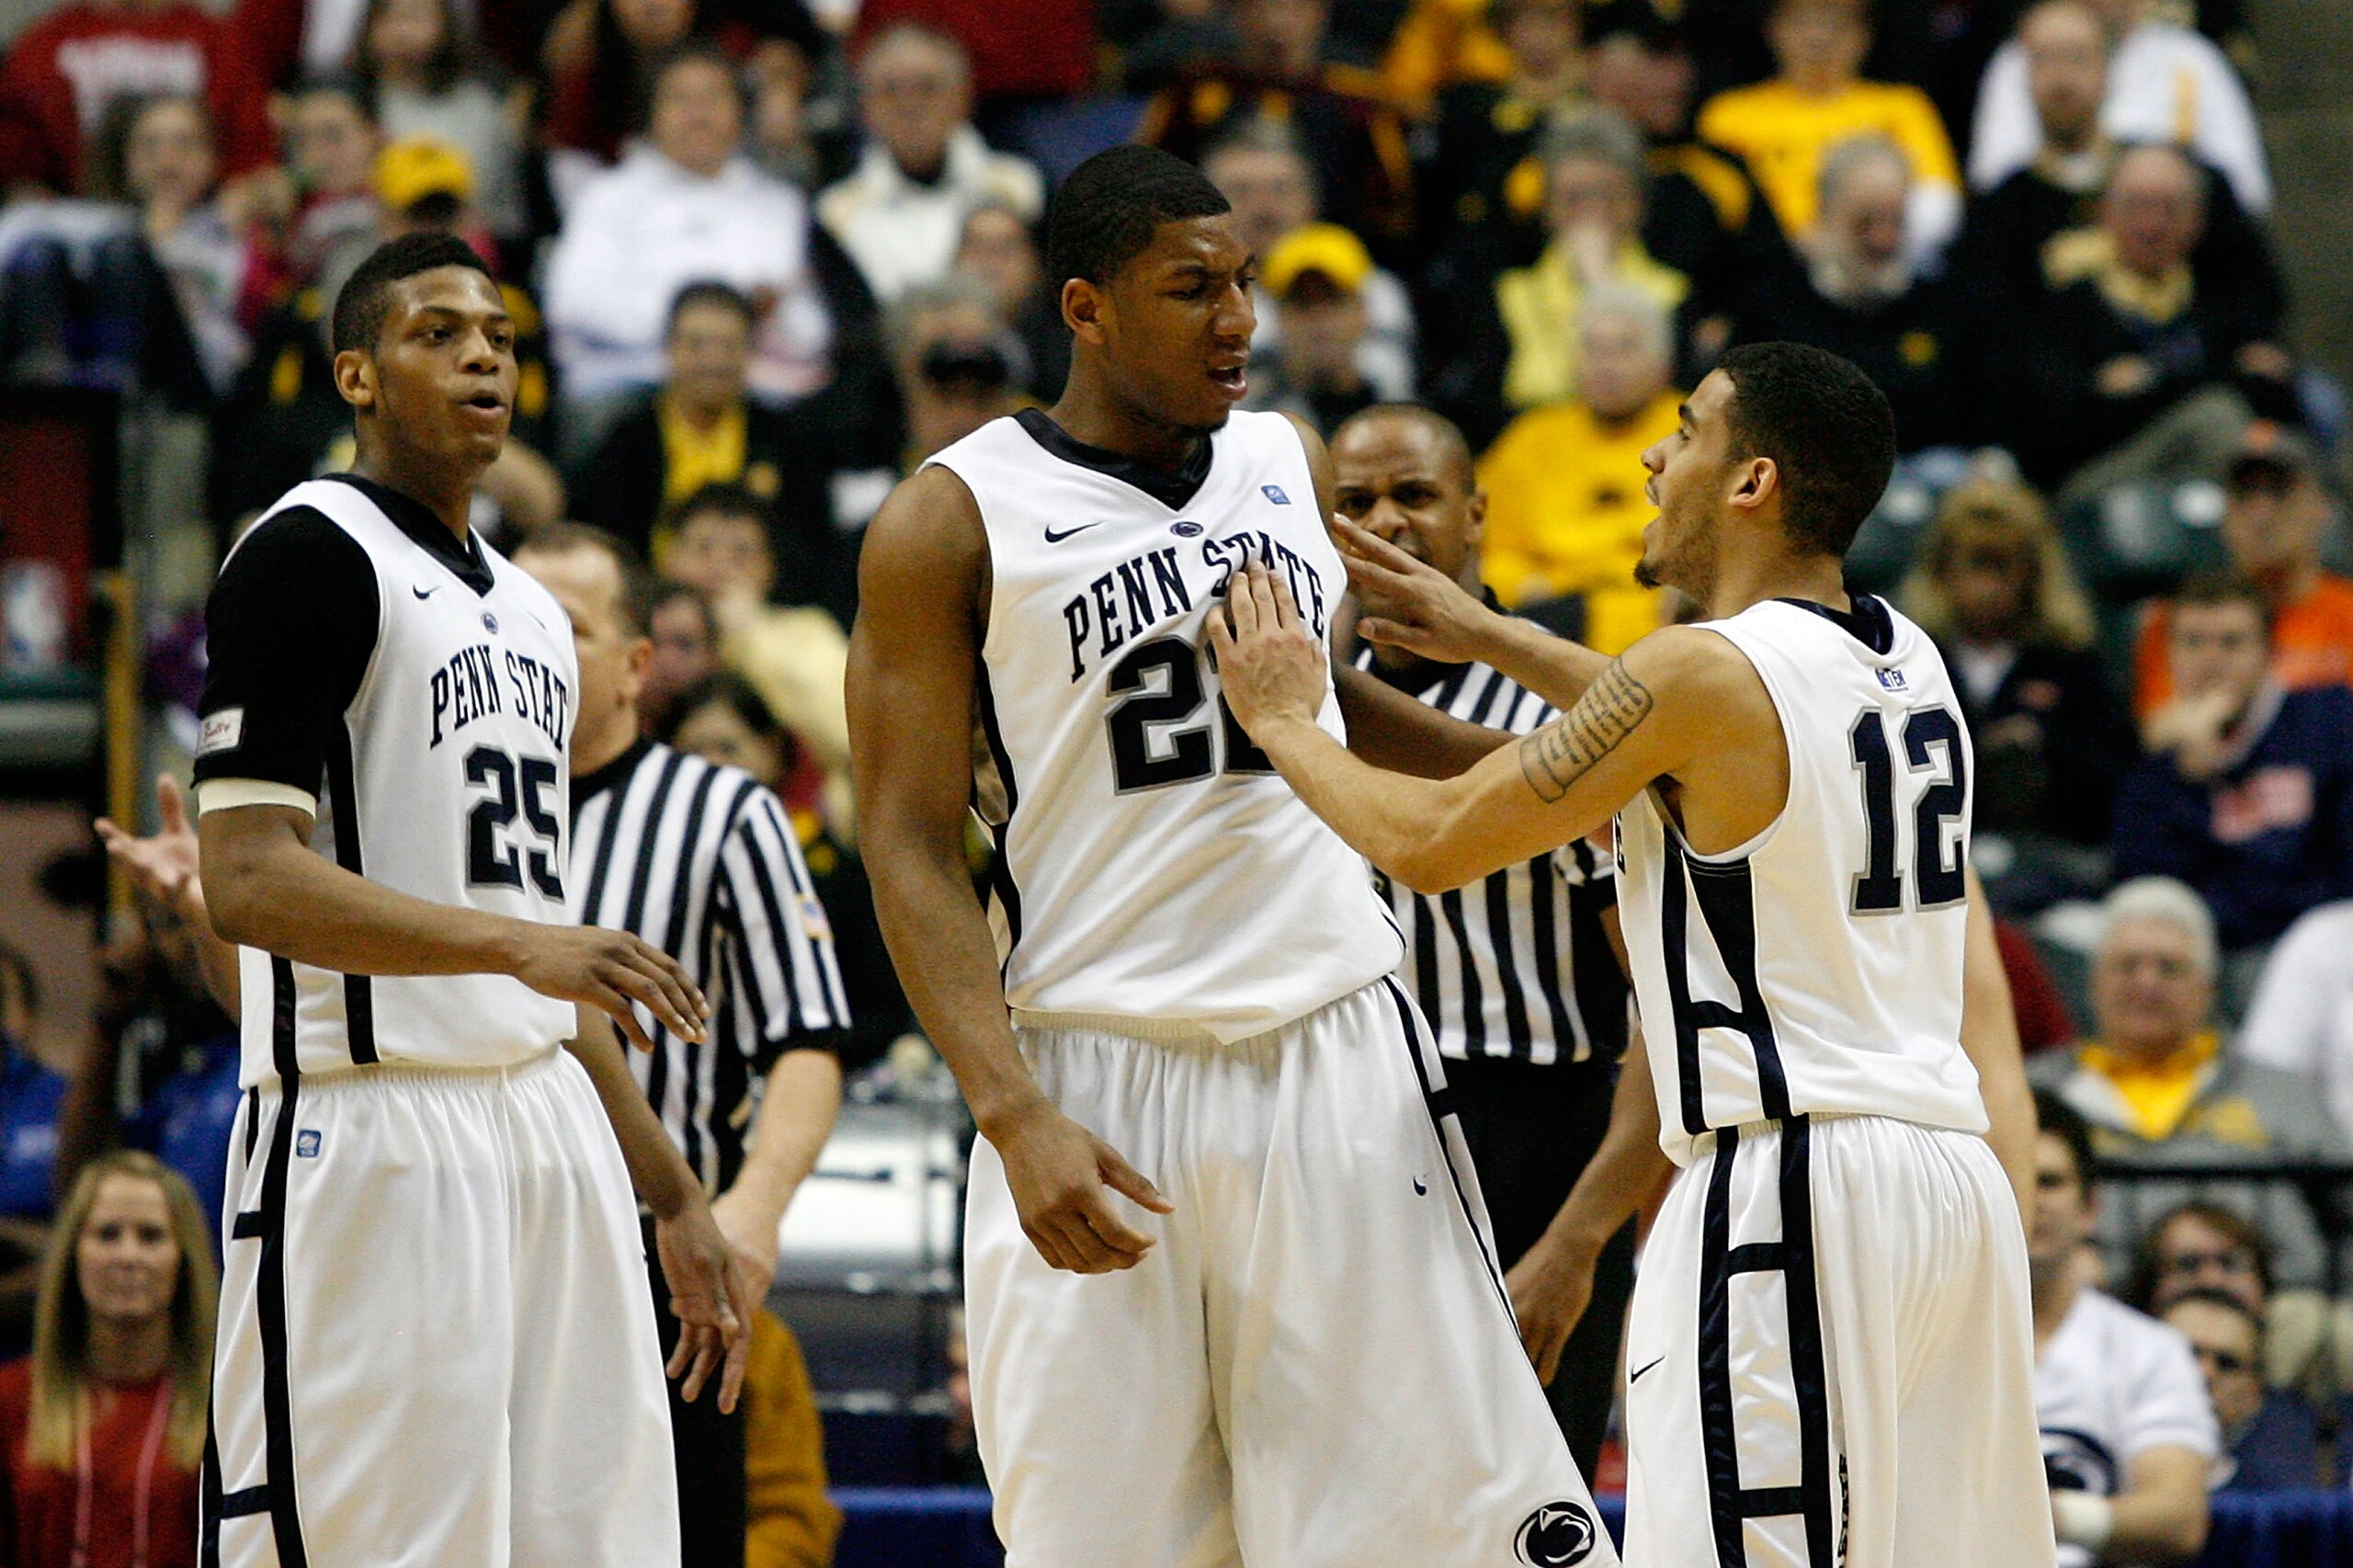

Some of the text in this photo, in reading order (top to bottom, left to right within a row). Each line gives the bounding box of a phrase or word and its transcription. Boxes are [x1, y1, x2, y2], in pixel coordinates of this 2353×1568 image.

[1063, 546, 1193, 683] PENN
[429, 644, 567, 752] PENN STAT
[461, 741, 566, 904] 25
[1847, 702, 1967, 916] 12
